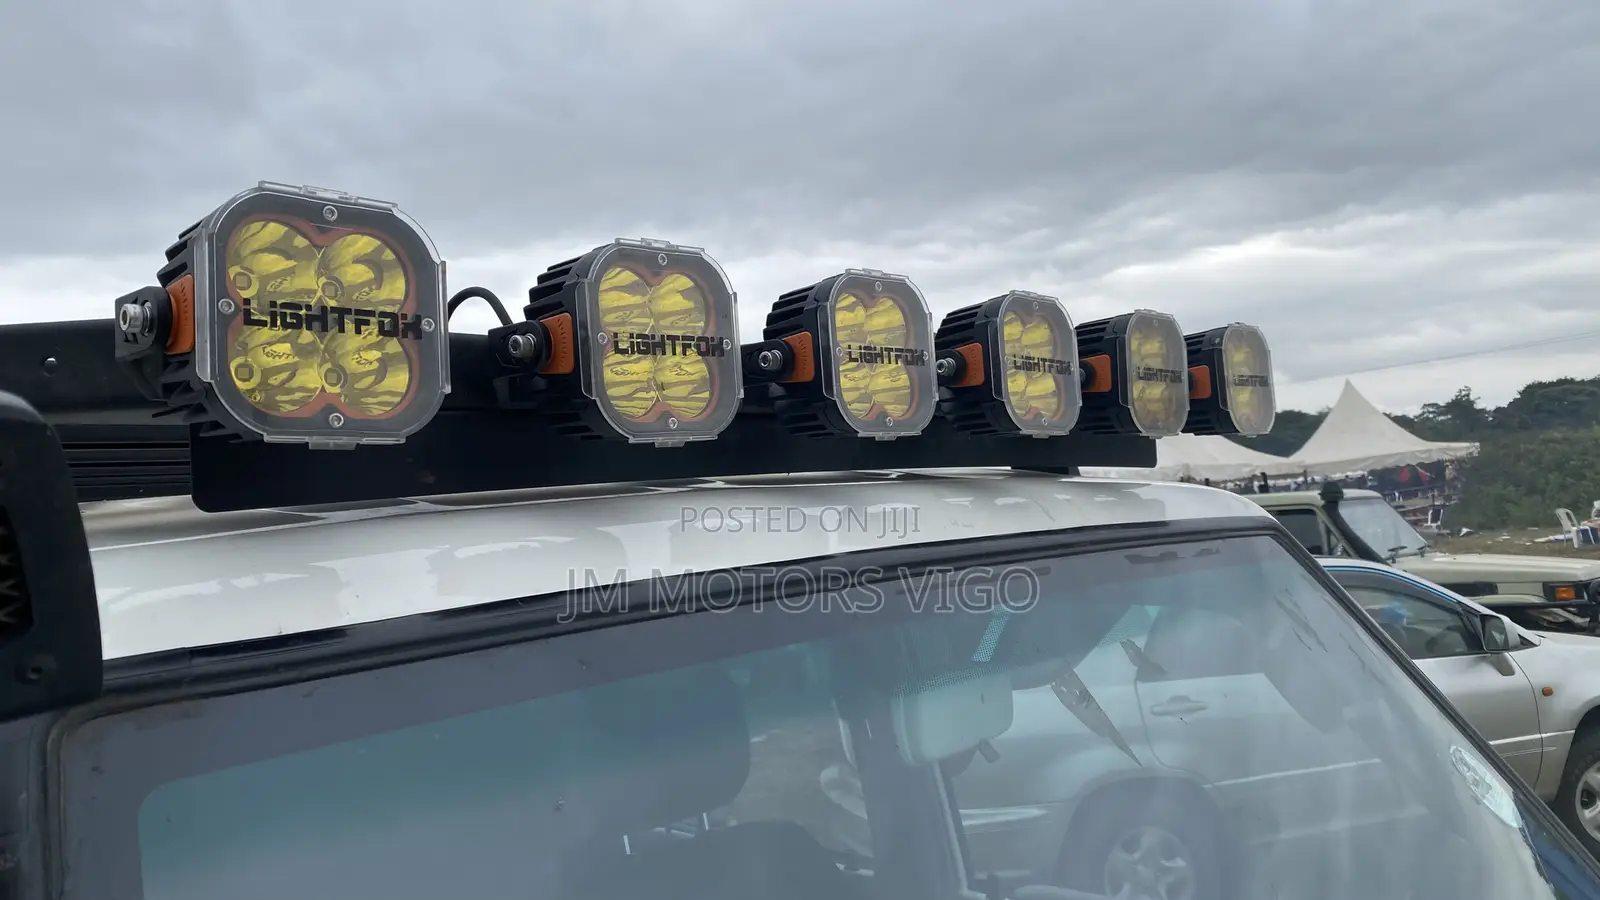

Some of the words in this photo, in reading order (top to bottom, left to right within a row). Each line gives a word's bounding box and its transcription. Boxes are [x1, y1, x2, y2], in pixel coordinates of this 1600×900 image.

[243, 298, 422, 340] LIGHTFOX
[613, 332, 725, 357] LIGHTFOX
[847, 344, 925, 366] LIGHTFOX
